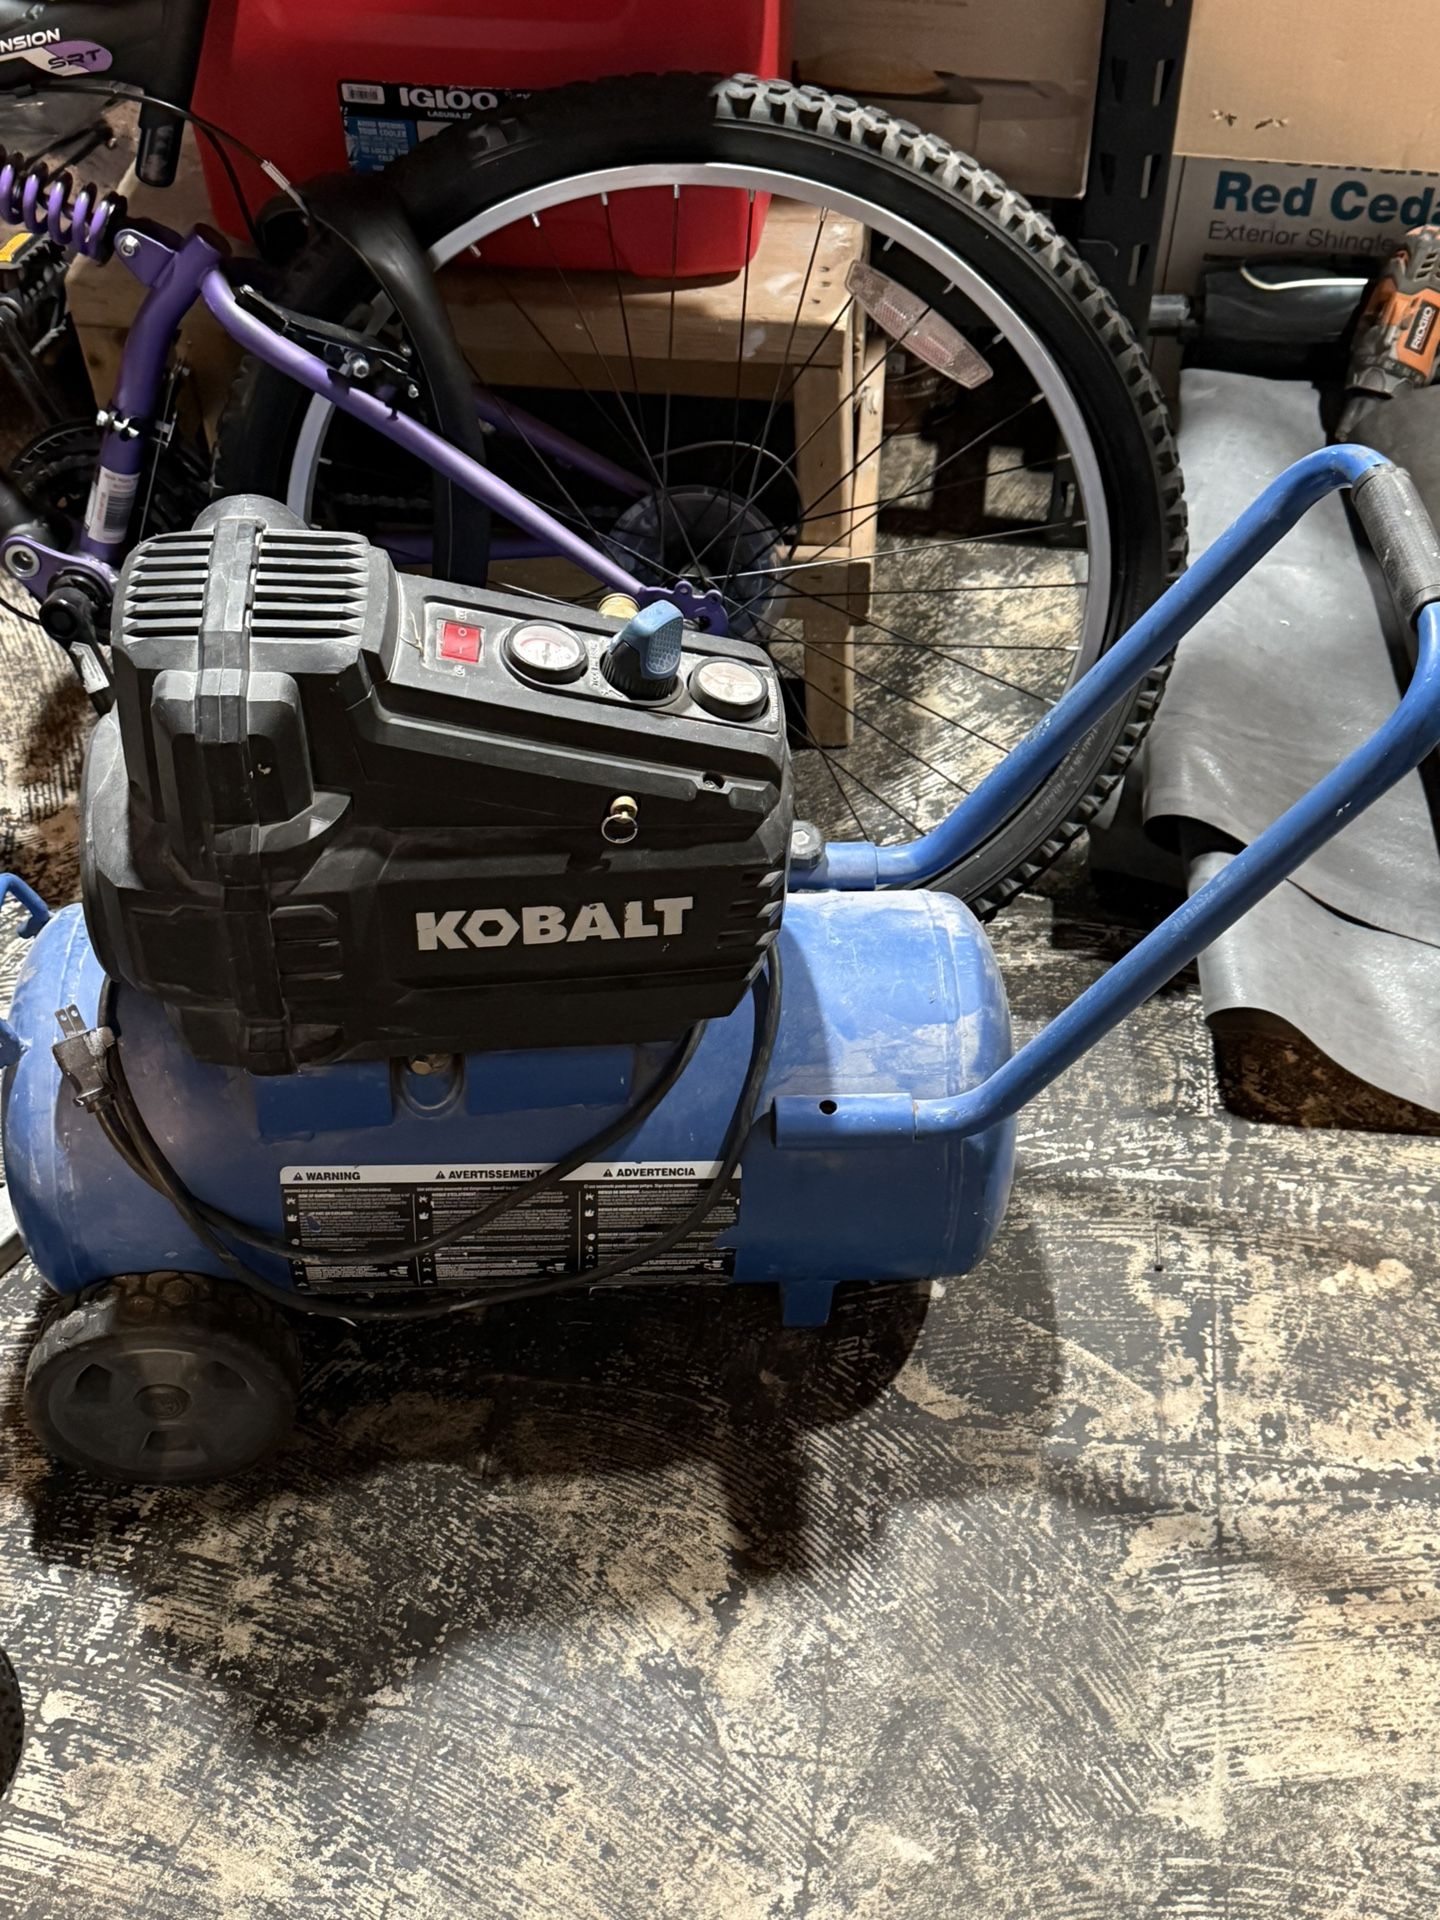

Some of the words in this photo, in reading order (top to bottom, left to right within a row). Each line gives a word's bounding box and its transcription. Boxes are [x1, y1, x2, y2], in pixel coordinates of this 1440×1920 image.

[0, 28, 60, 53] NSION
[48, 50, 102, 70] SRT
[399, 87, 498, 110] IGLOO
[1213, 170, 1317, 217] Red
[1208, 220, 1300, 246] Exterior
[416, 896, 694, 951] KOBALT
[305, 1172, 361, 1181] WARNING
[449, 1170, 542, 1179] AVERTISSEMENT
[616, 1168, 695, 1178] ADVERTENCIA
